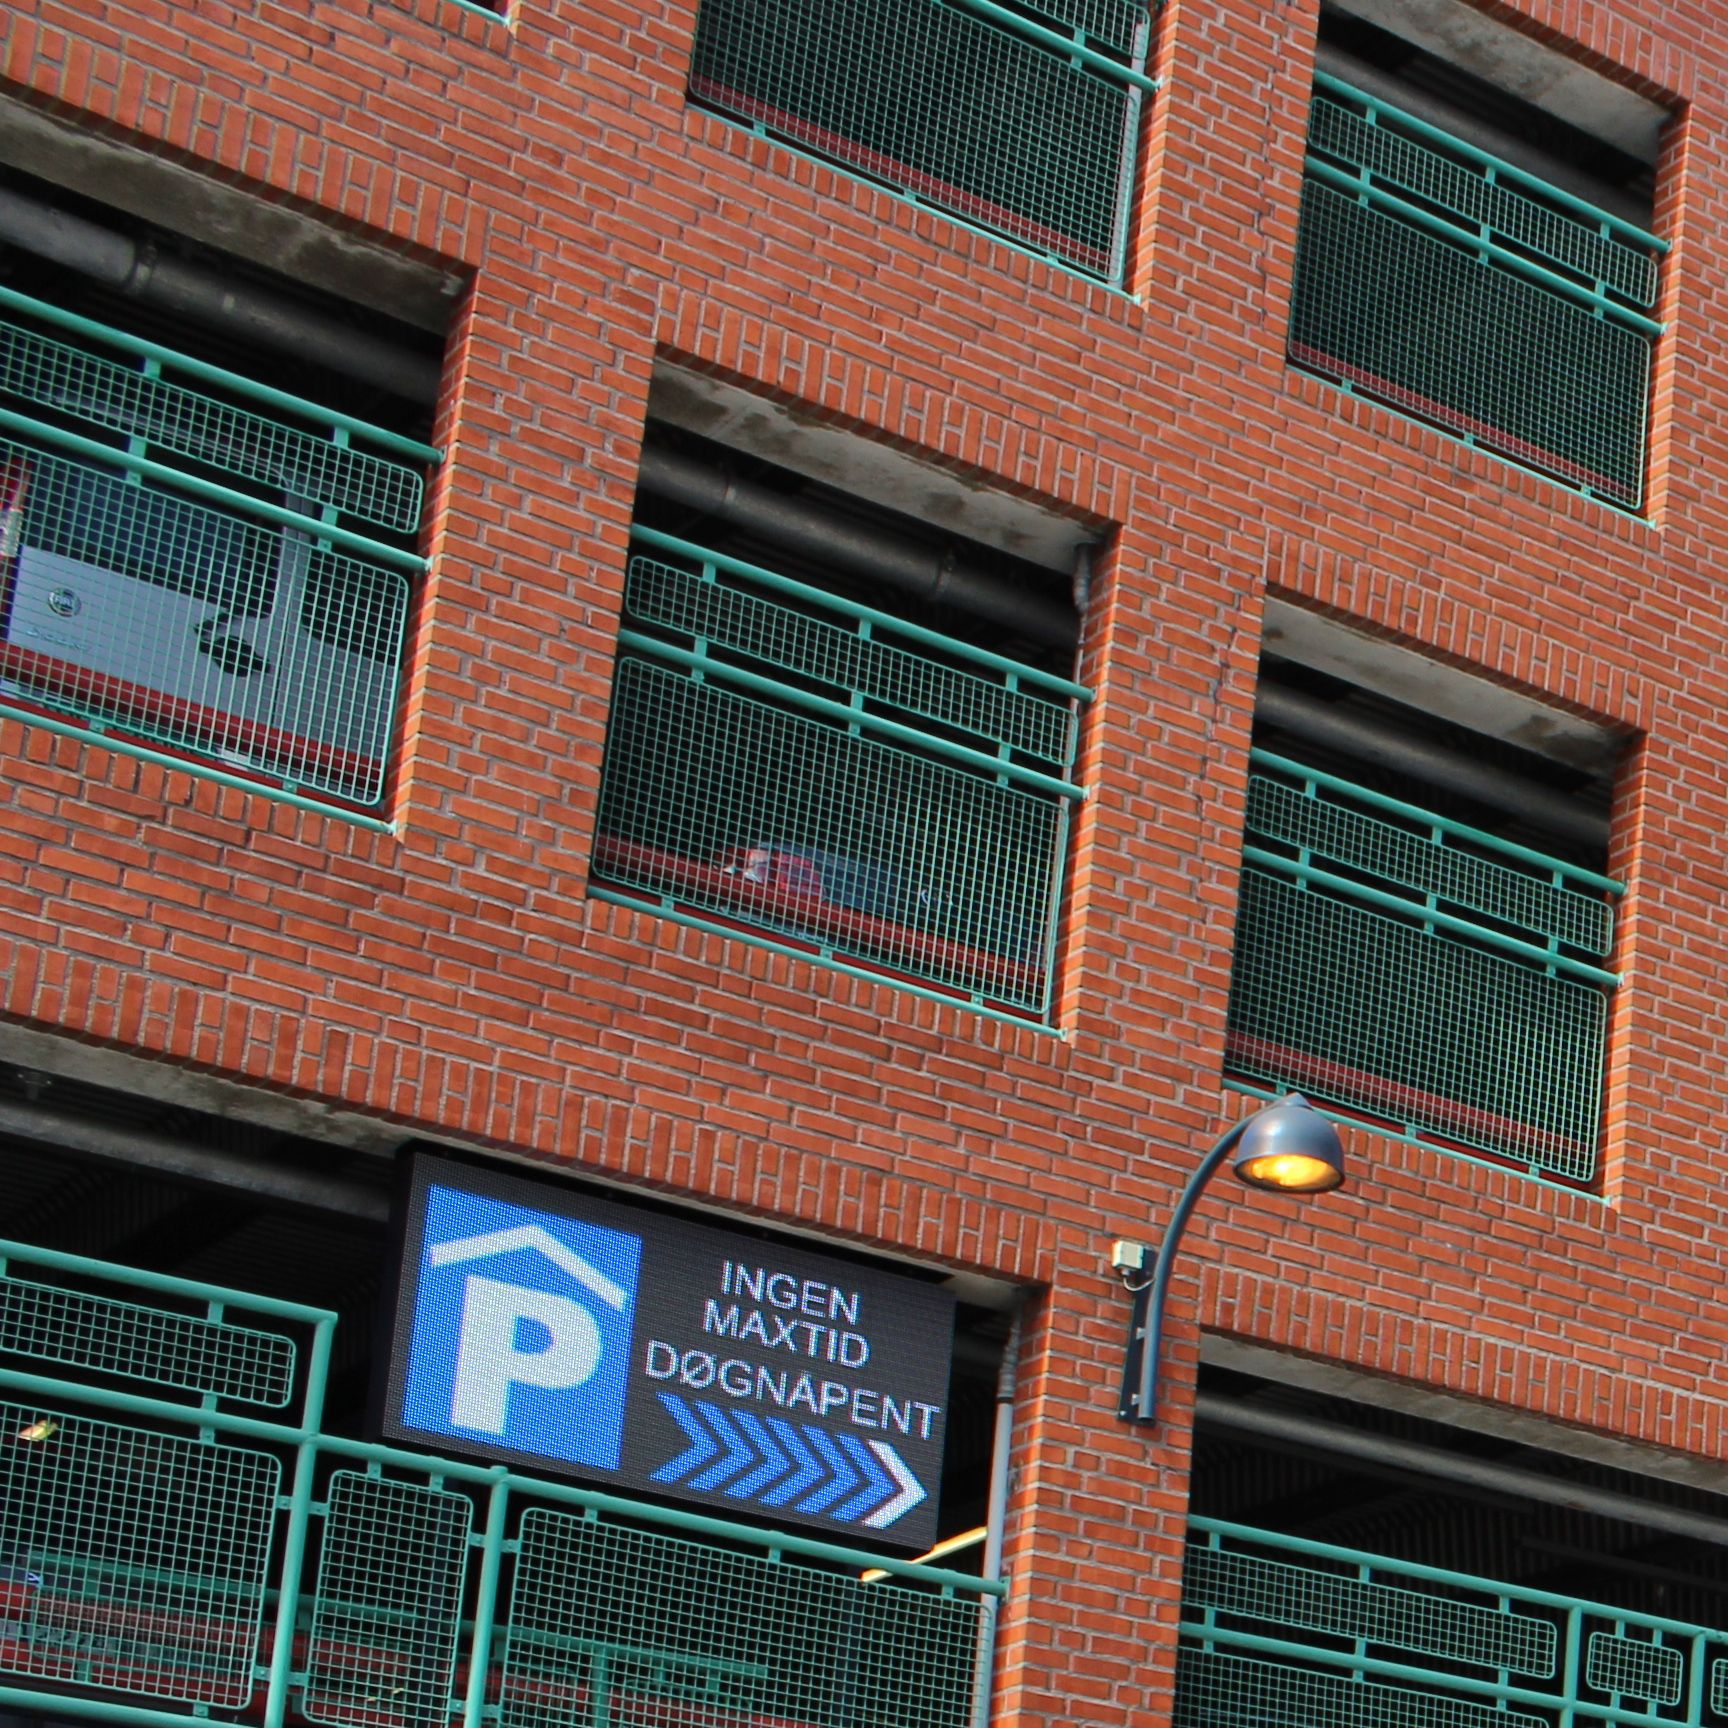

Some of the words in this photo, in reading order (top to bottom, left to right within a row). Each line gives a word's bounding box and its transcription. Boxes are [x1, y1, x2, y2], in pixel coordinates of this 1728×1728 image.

[721, 1260, 861, 1325] INGEN
[451, 1275, 600, 1435] P
[703, 1298, 870, 1369] MAXTID
